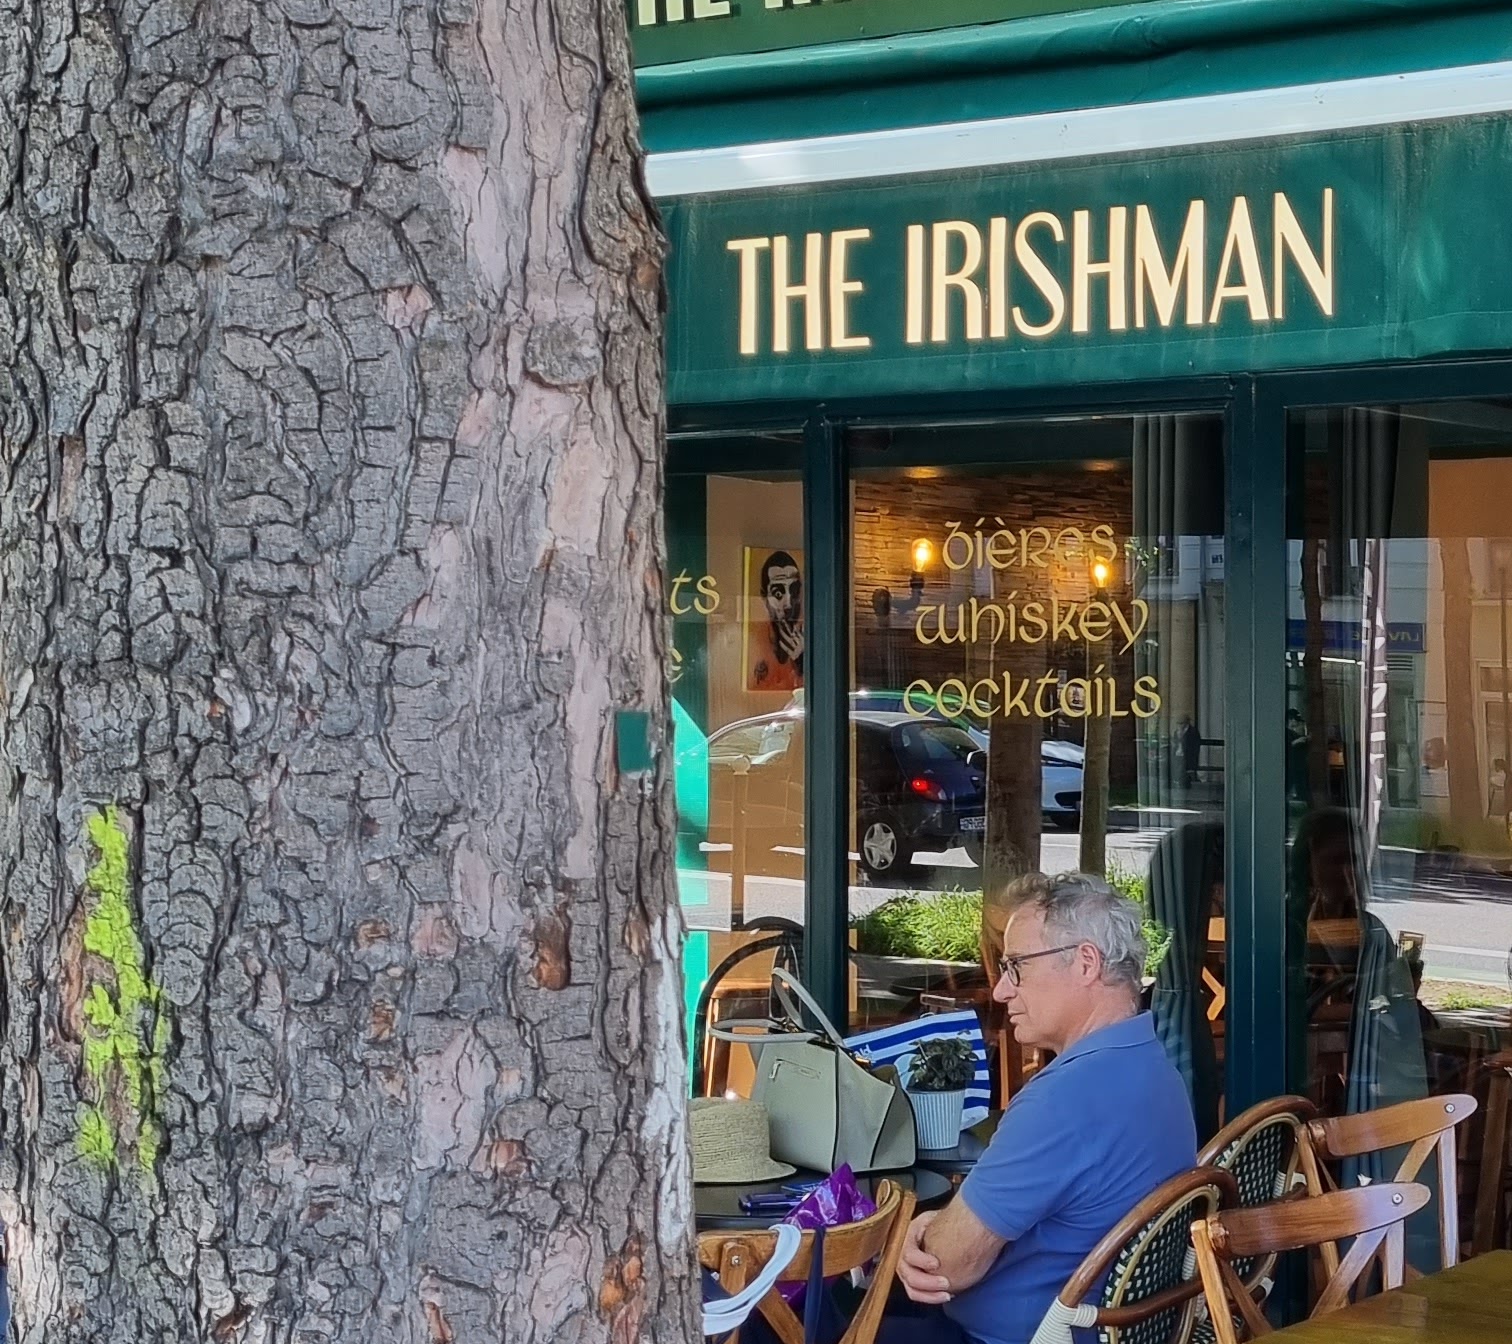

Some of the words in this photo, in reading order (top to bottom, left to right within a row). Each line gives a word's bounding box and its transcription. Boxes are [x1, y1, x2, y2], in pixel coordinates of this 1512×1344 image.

[726, 226, 872, 357] THE
[905, 187, 1336, 346] IRISHMAN
[914, 589, 1149, 656] whiskey
[903, 663, 1162, 718] cocktails
